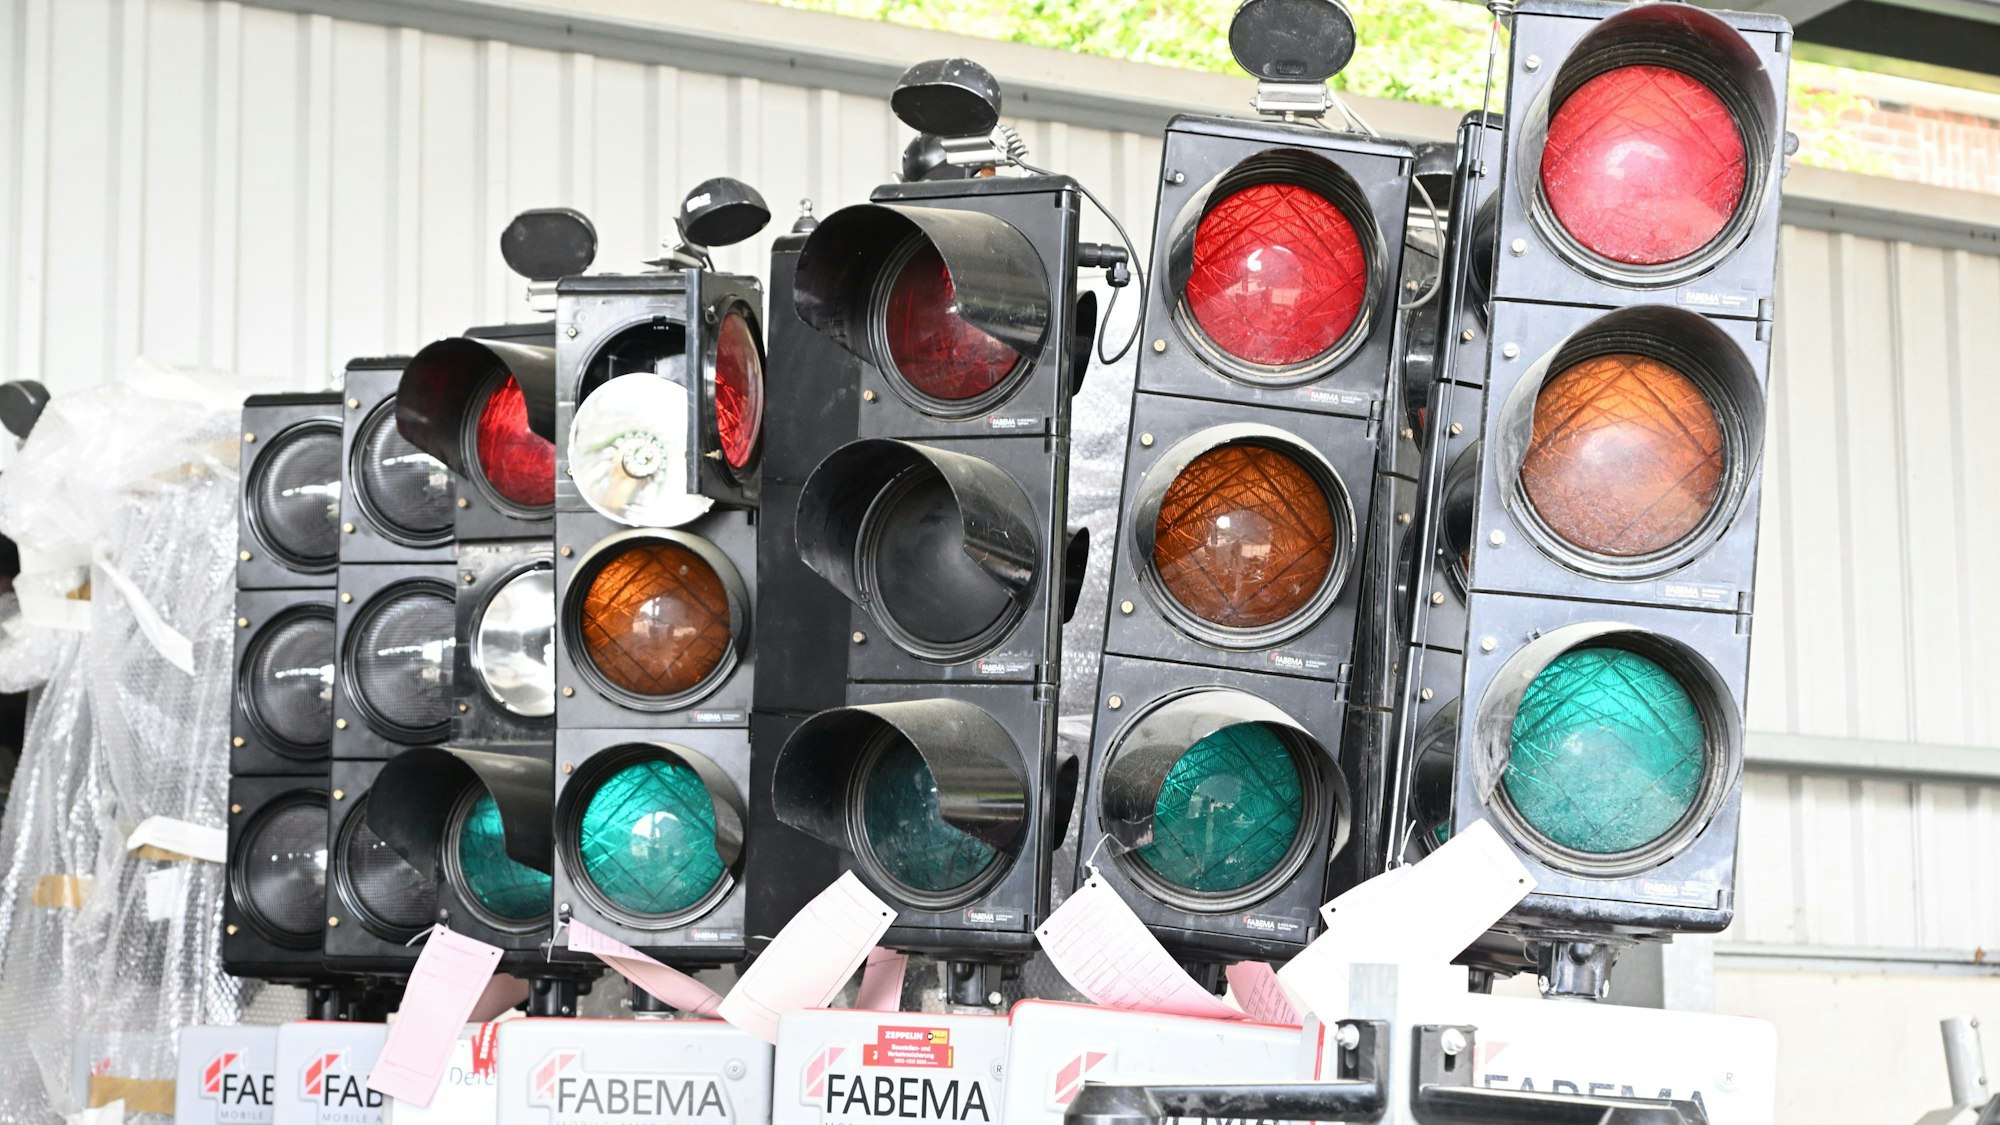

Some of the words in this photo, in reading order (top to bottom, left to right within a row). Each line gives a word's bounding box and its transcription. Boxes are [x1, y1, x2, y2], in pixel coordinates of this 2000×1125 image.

[885, 1031, 923, 1040] ZEPPELIN
[557, 1077, 726, 1117] FABEMA
[826, 1073, 990, 1122] FABEMA
[220, 1109, 264, 1121] MOBILE
[321, 1112, 368, 1124] MOBILE
